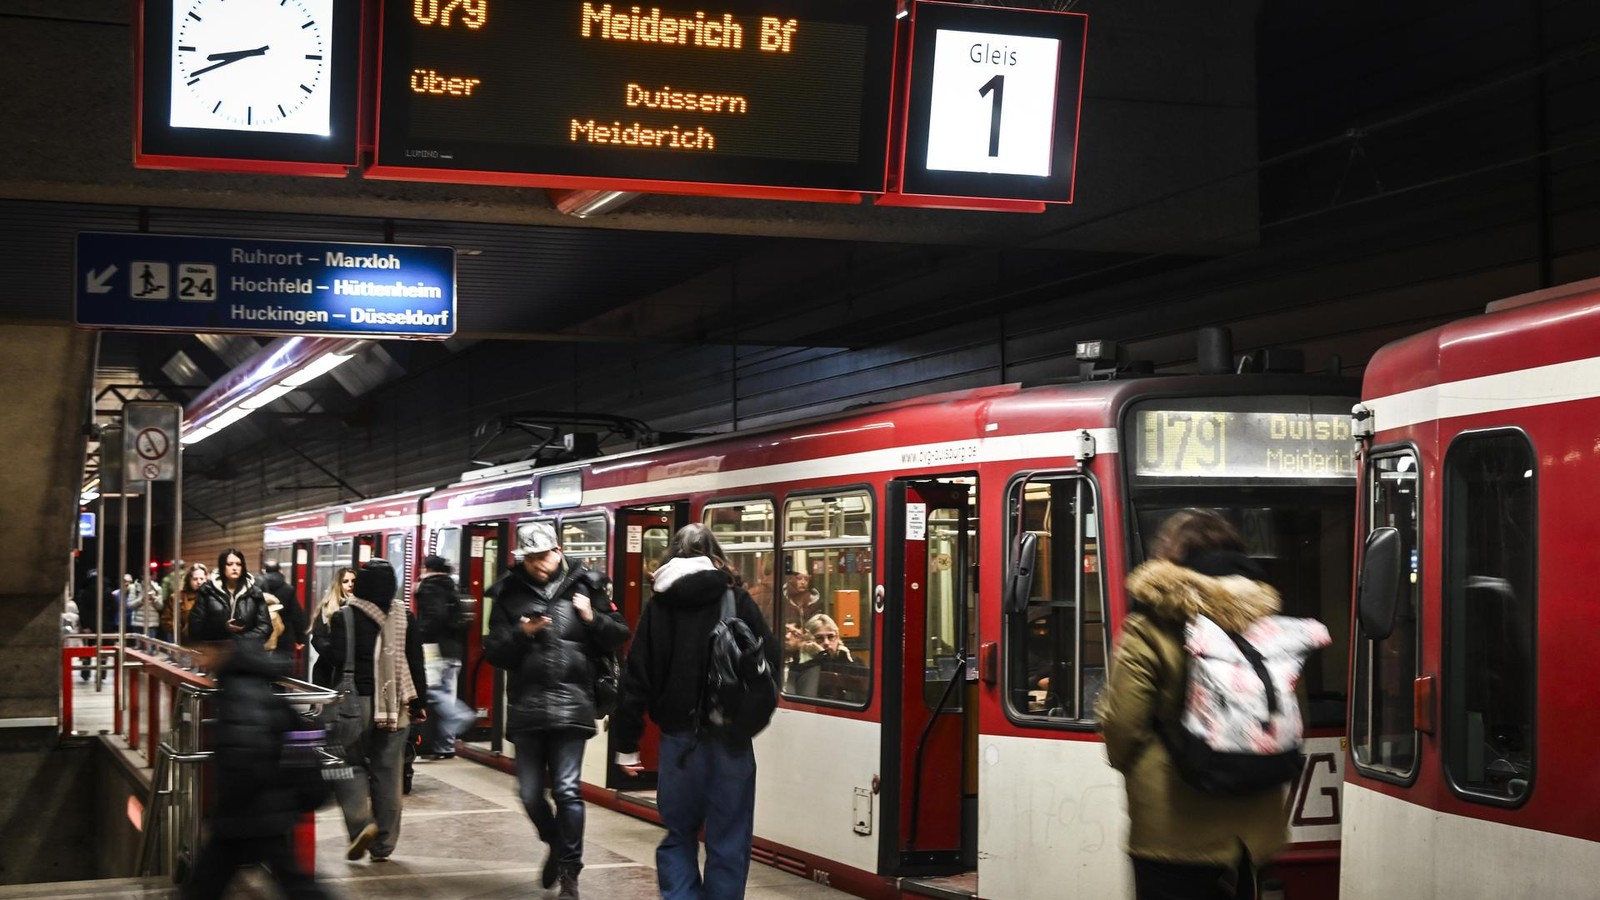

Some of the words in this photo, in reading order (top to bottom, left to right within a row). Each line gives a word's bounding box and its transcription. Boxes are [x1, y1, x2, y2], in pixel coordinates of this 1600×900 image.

[582, 2, 742, 48] Meiderich
[760, 16, 797, 51] Bf
[970, 43, 1017, 66] Gleis
[411, 69, 480, 95] über
[626, 84, 747, 113] Duissern
[978, 74, 1005, 157] 1
[570, 119, 714, 149] Meiderich
[231, 248, 303, 266] Ruhrort
[325, 251, 401, 270] Marxloh
[231, 276, 313, 295] Hochfeld
[333, 279, 442, 300] Hüttenheim
[231, 304, 329, 326] Huckingen
[350, 307, 450, 327] Düsseldorf
